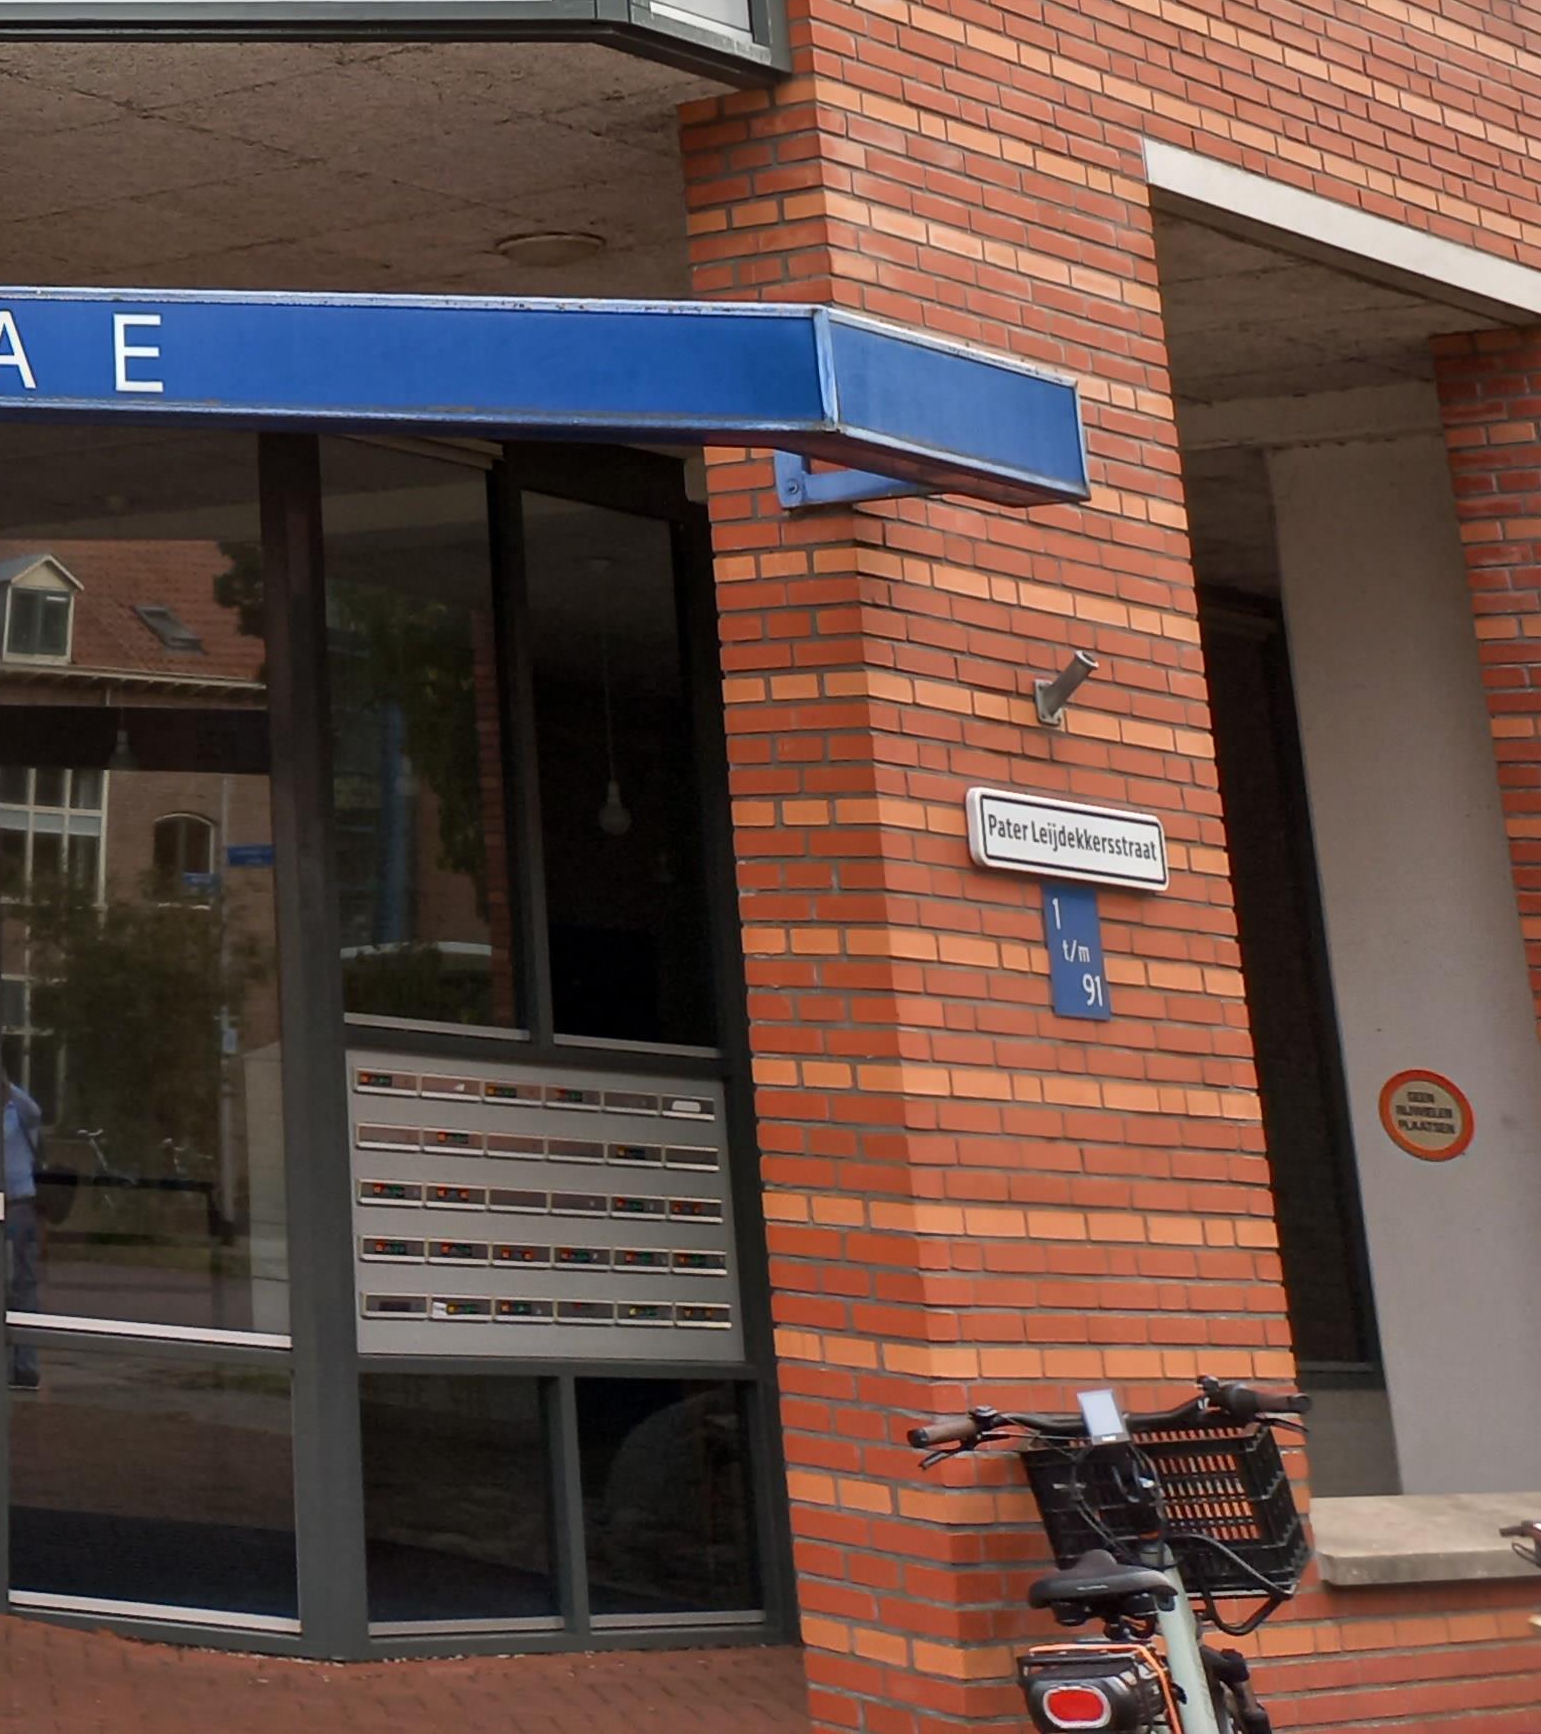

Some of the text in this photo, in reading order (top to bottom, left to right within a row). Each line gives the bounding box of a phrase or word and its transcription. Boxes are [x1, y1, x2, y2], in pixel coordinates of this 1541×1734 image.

[988, 814, 1157, 860] Pater Leijdekkersstraat
[1052, 898, 1061, 930] 1
[1062, 939, 1091, 963] t/m
[1082, 974, 1103, 1008] 91
